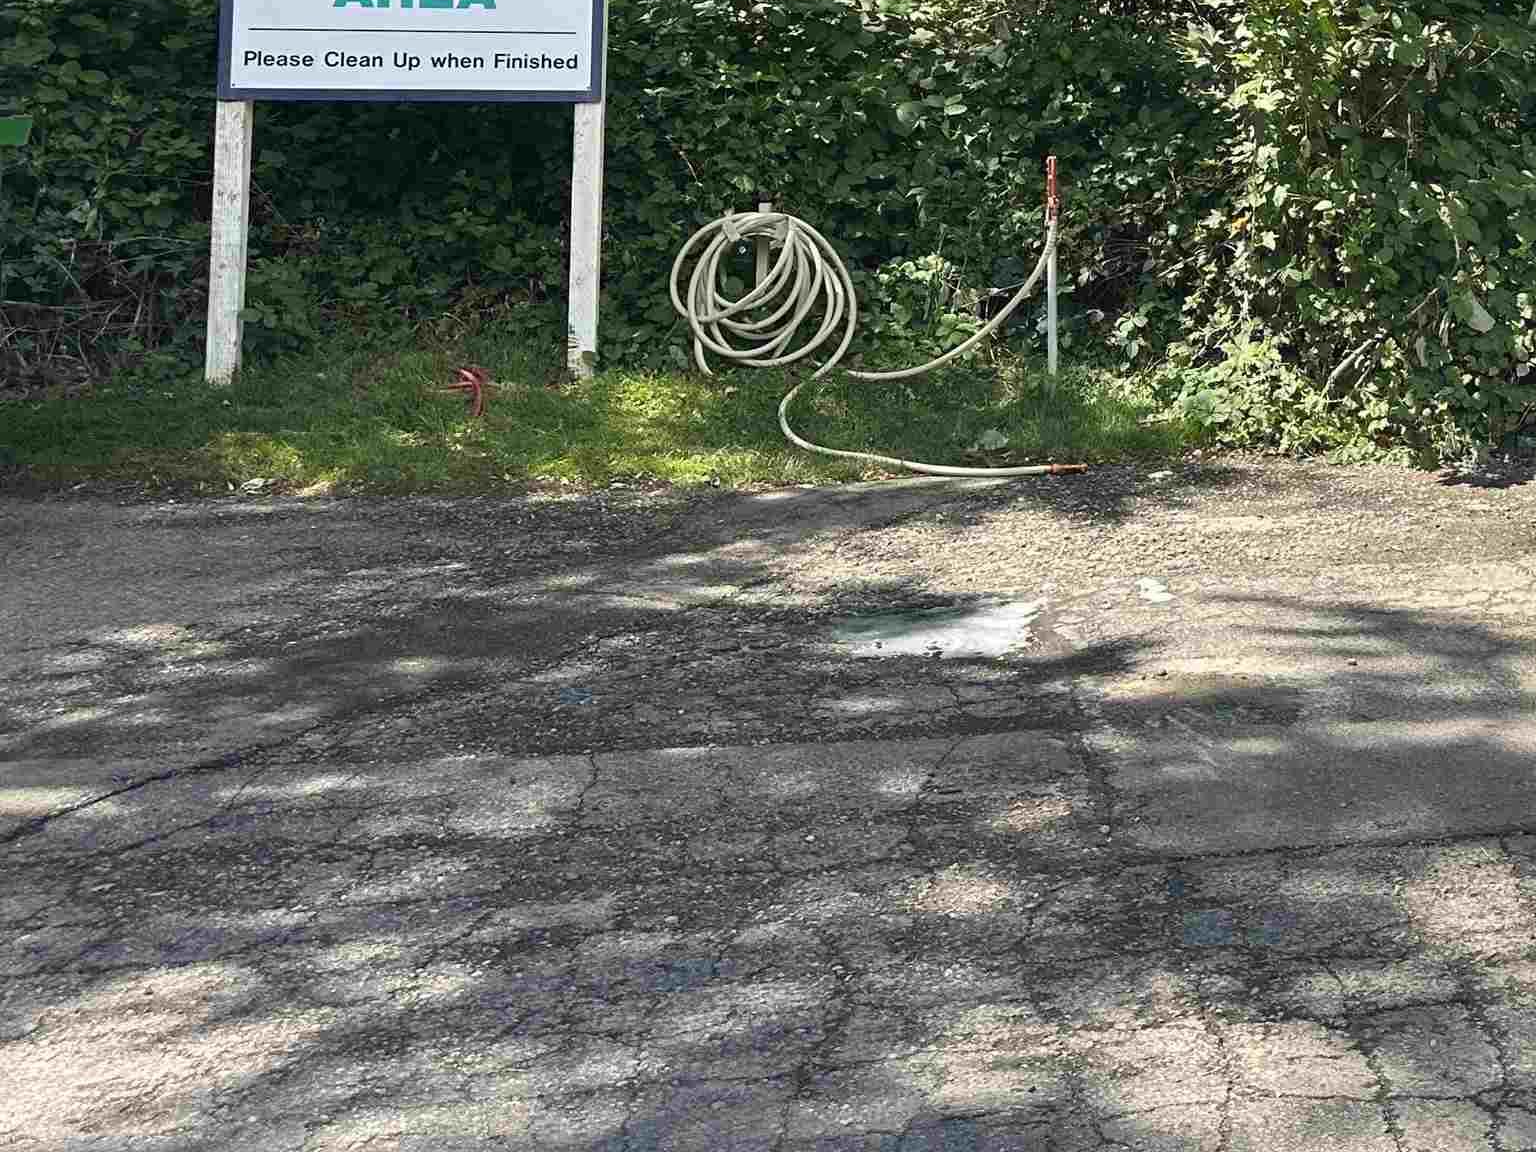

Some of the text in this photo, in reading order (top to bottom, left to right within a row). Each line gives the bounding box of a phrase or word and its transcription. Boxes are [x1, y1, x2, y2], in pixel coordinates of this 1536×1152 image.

[243, 50, 579, 71] Please Clean Up when Finished
